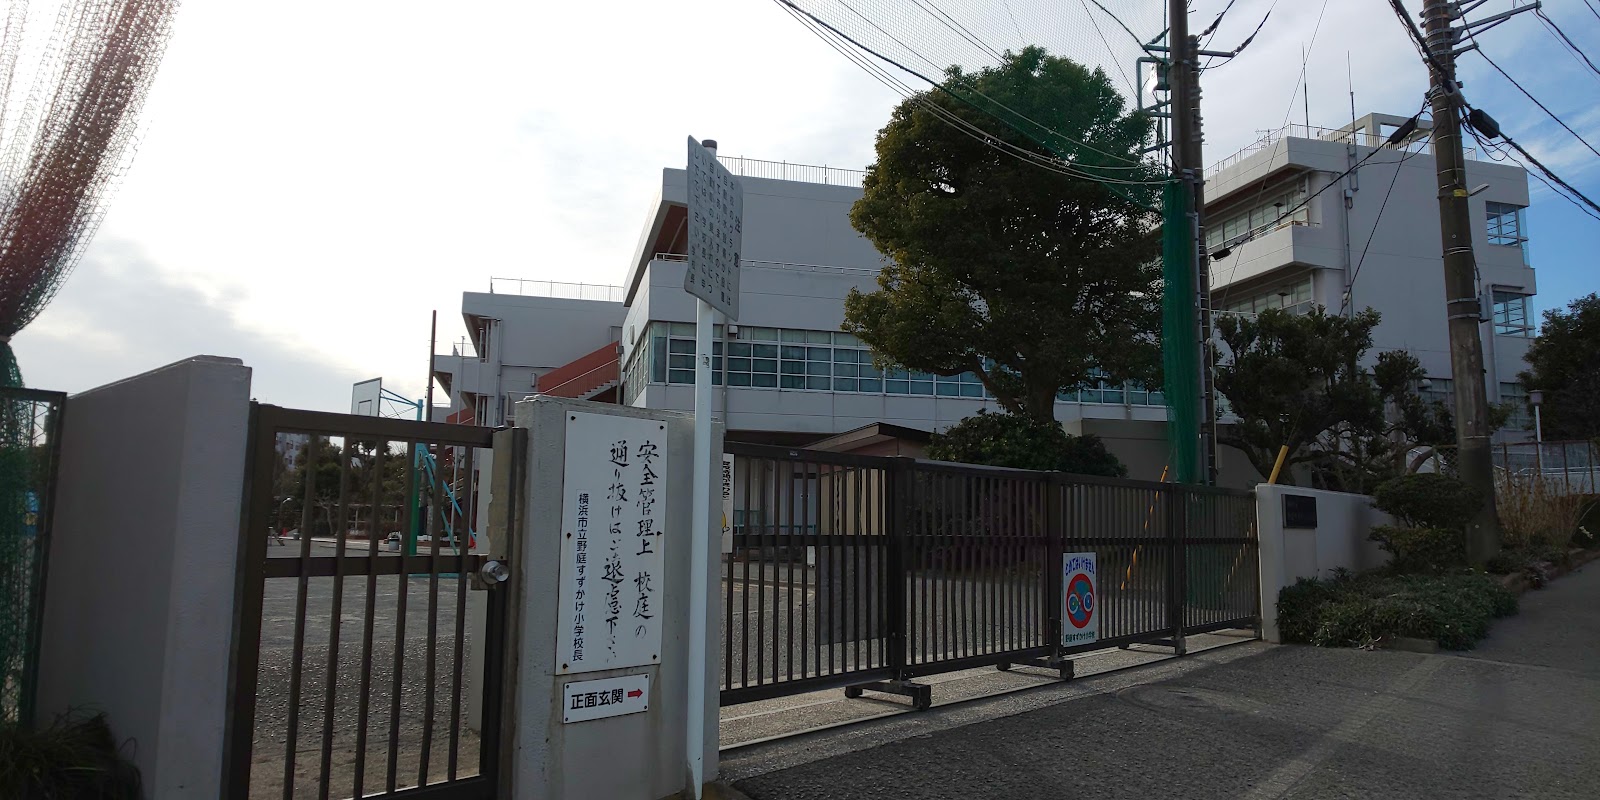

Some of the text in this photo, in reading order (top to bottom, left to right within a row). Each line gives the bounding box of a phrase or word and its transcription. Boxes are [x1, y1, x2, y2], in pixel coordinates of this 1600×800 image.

[572, 493, 589, 662] 横浜市立野庭すずかけ小学校長
[632, 440, 660, 639] 安全管理上 校庭の
[570, 688, 624, 710] 正面玄関
